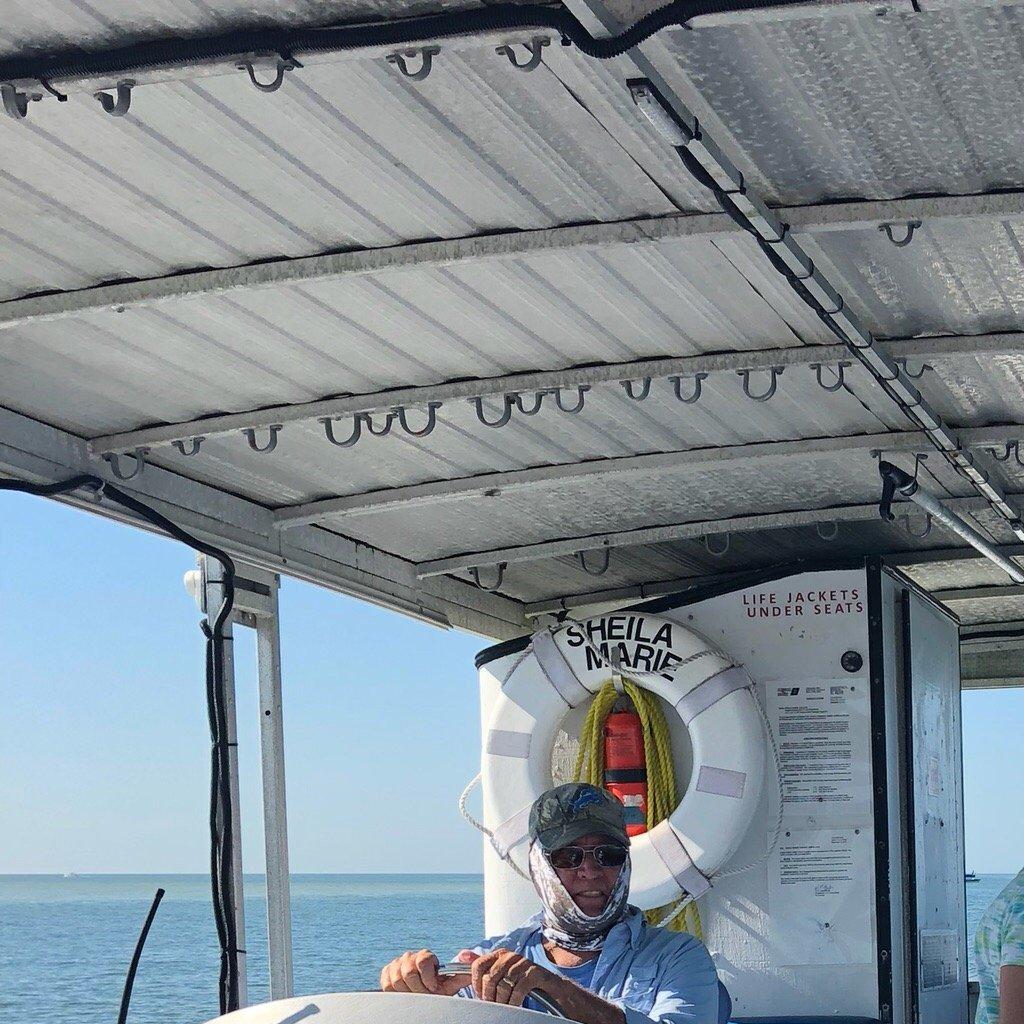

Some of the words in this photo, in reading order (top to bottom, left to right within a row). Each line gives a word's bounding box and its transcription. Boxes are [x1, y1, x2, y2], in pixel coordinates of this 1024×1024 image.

[743, 593, 777, 605] LIFE
[787, 589, 859, 603] JACKETS
[747, 605, 803, 618] UNDER
[814, 602, 864, 614] SEATS
[566, 616, 673, 648] SHEILA
[585, 641, 683, 682] MARIE
